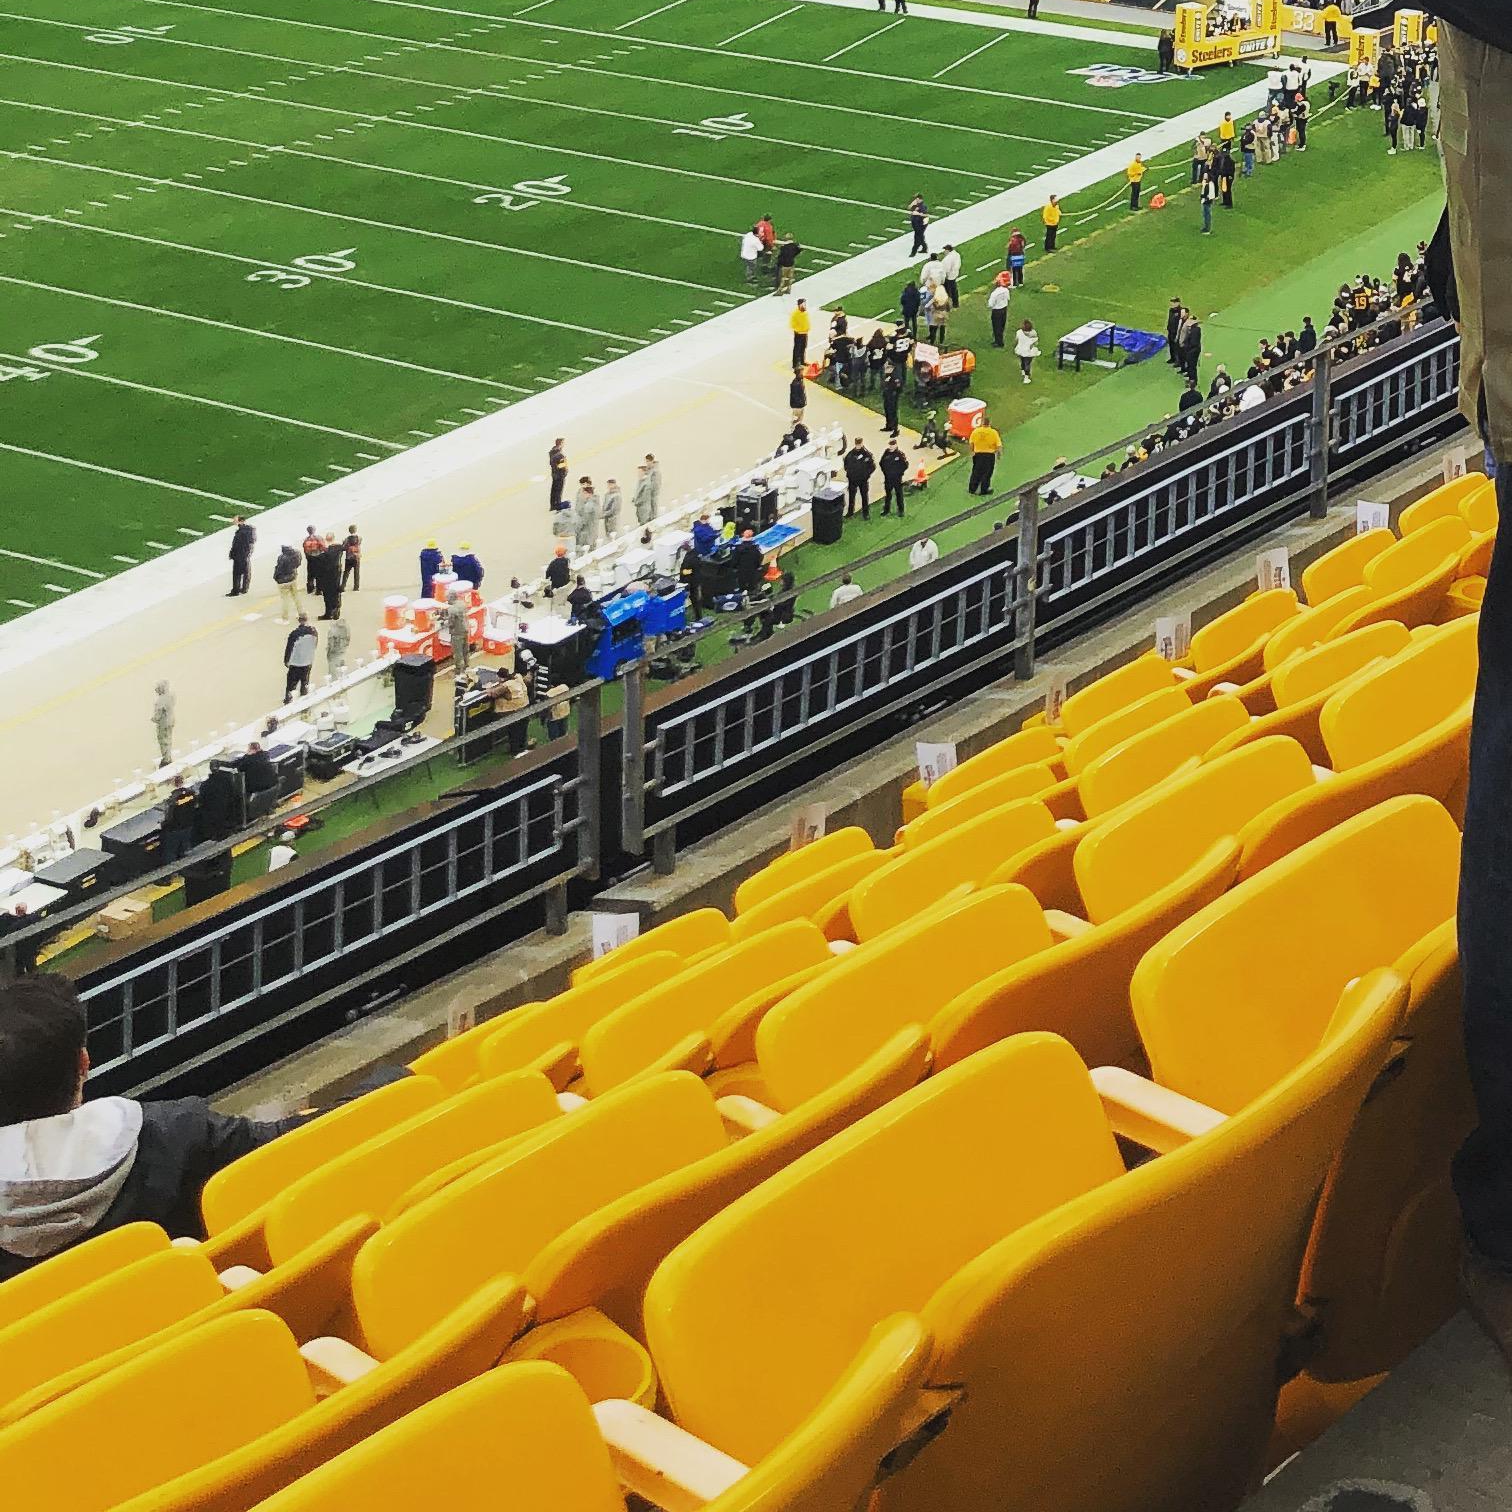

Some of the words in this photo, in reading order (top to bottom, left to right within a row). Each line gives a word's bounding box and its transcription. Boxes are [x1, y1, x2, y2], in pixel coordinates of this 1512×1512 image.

[1191, 45, 1233, 64] Steelers
[1240, 38, 1267, 54] UNITE
[472, 177, 573, 212] 20
[244, 251, 357, 289] 30
